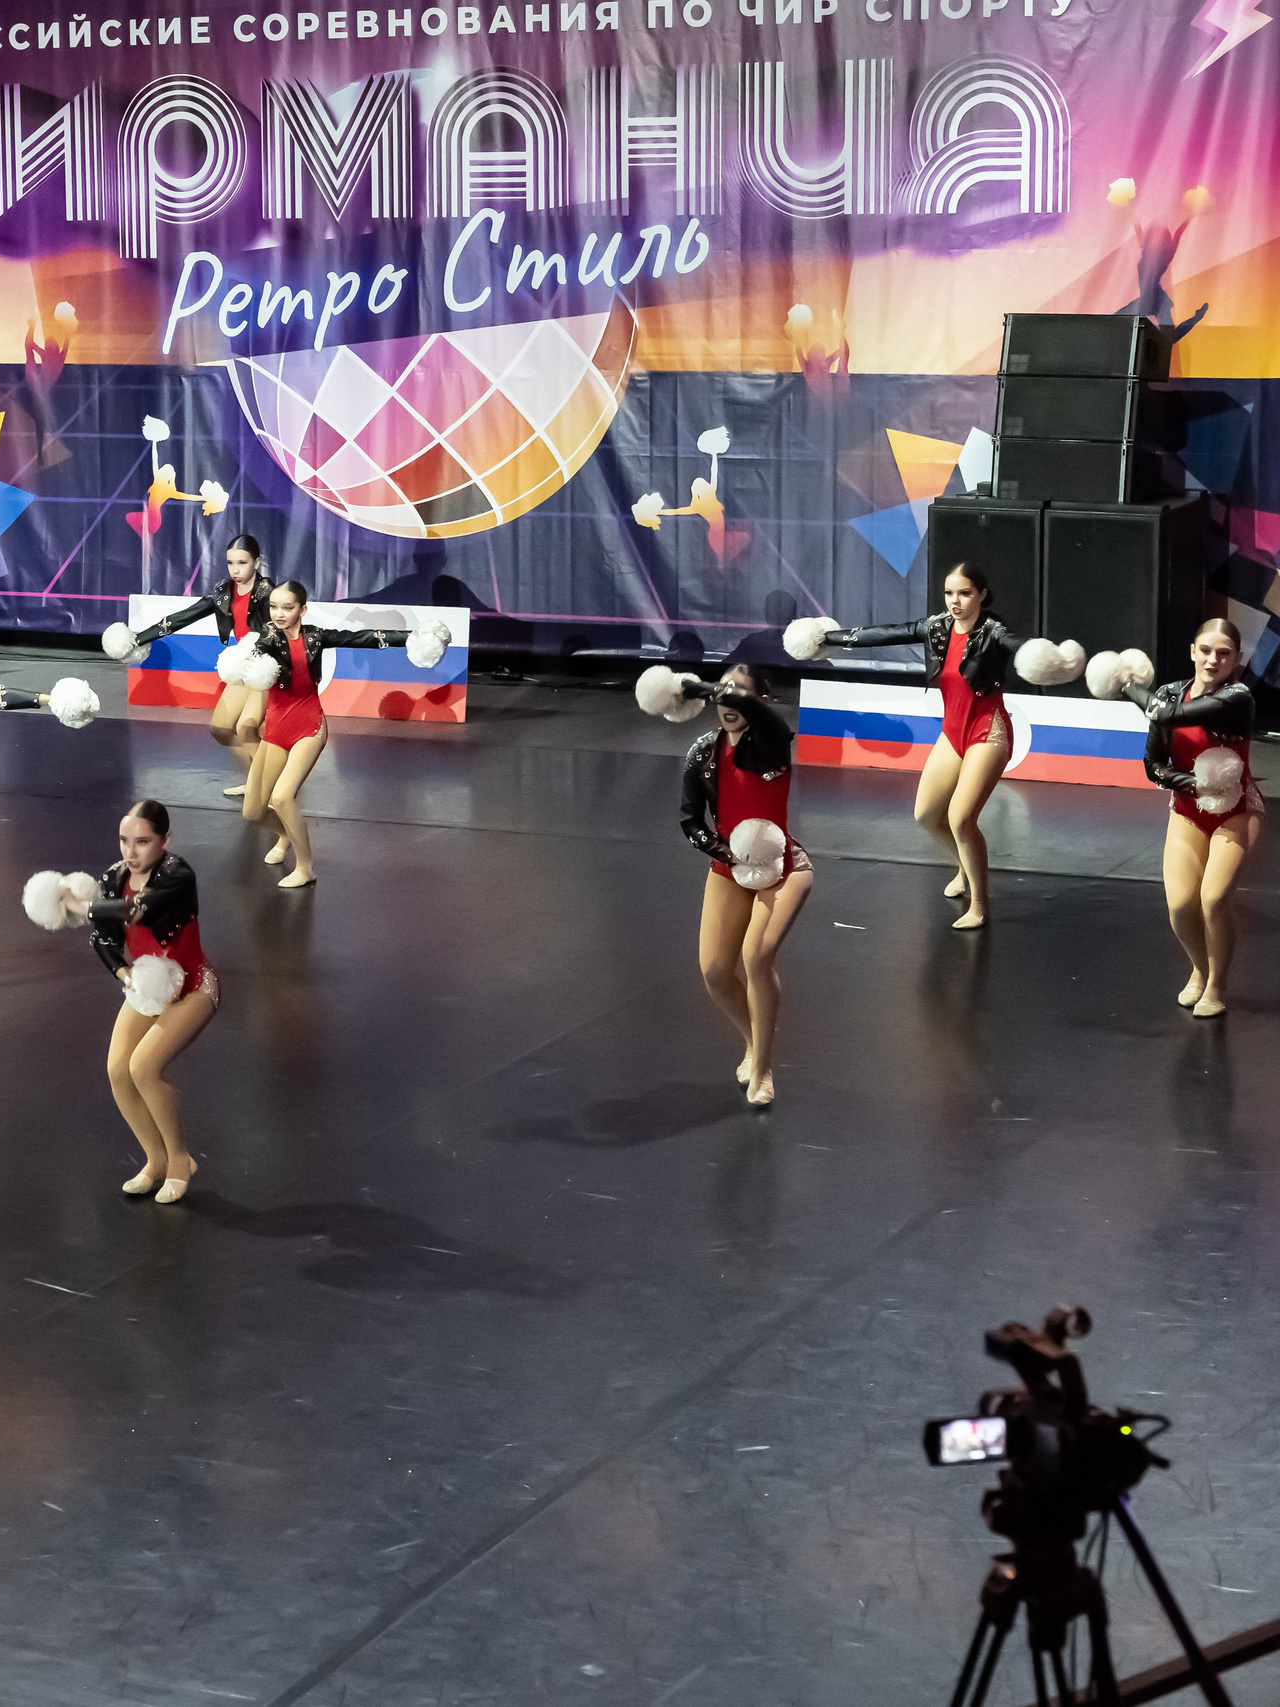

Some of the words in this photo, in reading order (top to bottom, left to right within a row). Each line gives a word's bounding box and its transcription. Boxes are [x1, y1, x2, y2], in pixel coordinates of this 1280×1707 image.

[233, 1, 619, 42] СОРЕВНОВАНИЯ
[647, 0, 713, 28] ПО
[738, 0, 838, 25] ЧИР
[162, 250, 408, 355] Ретро
[443, 207, 710, 312] Стиль
